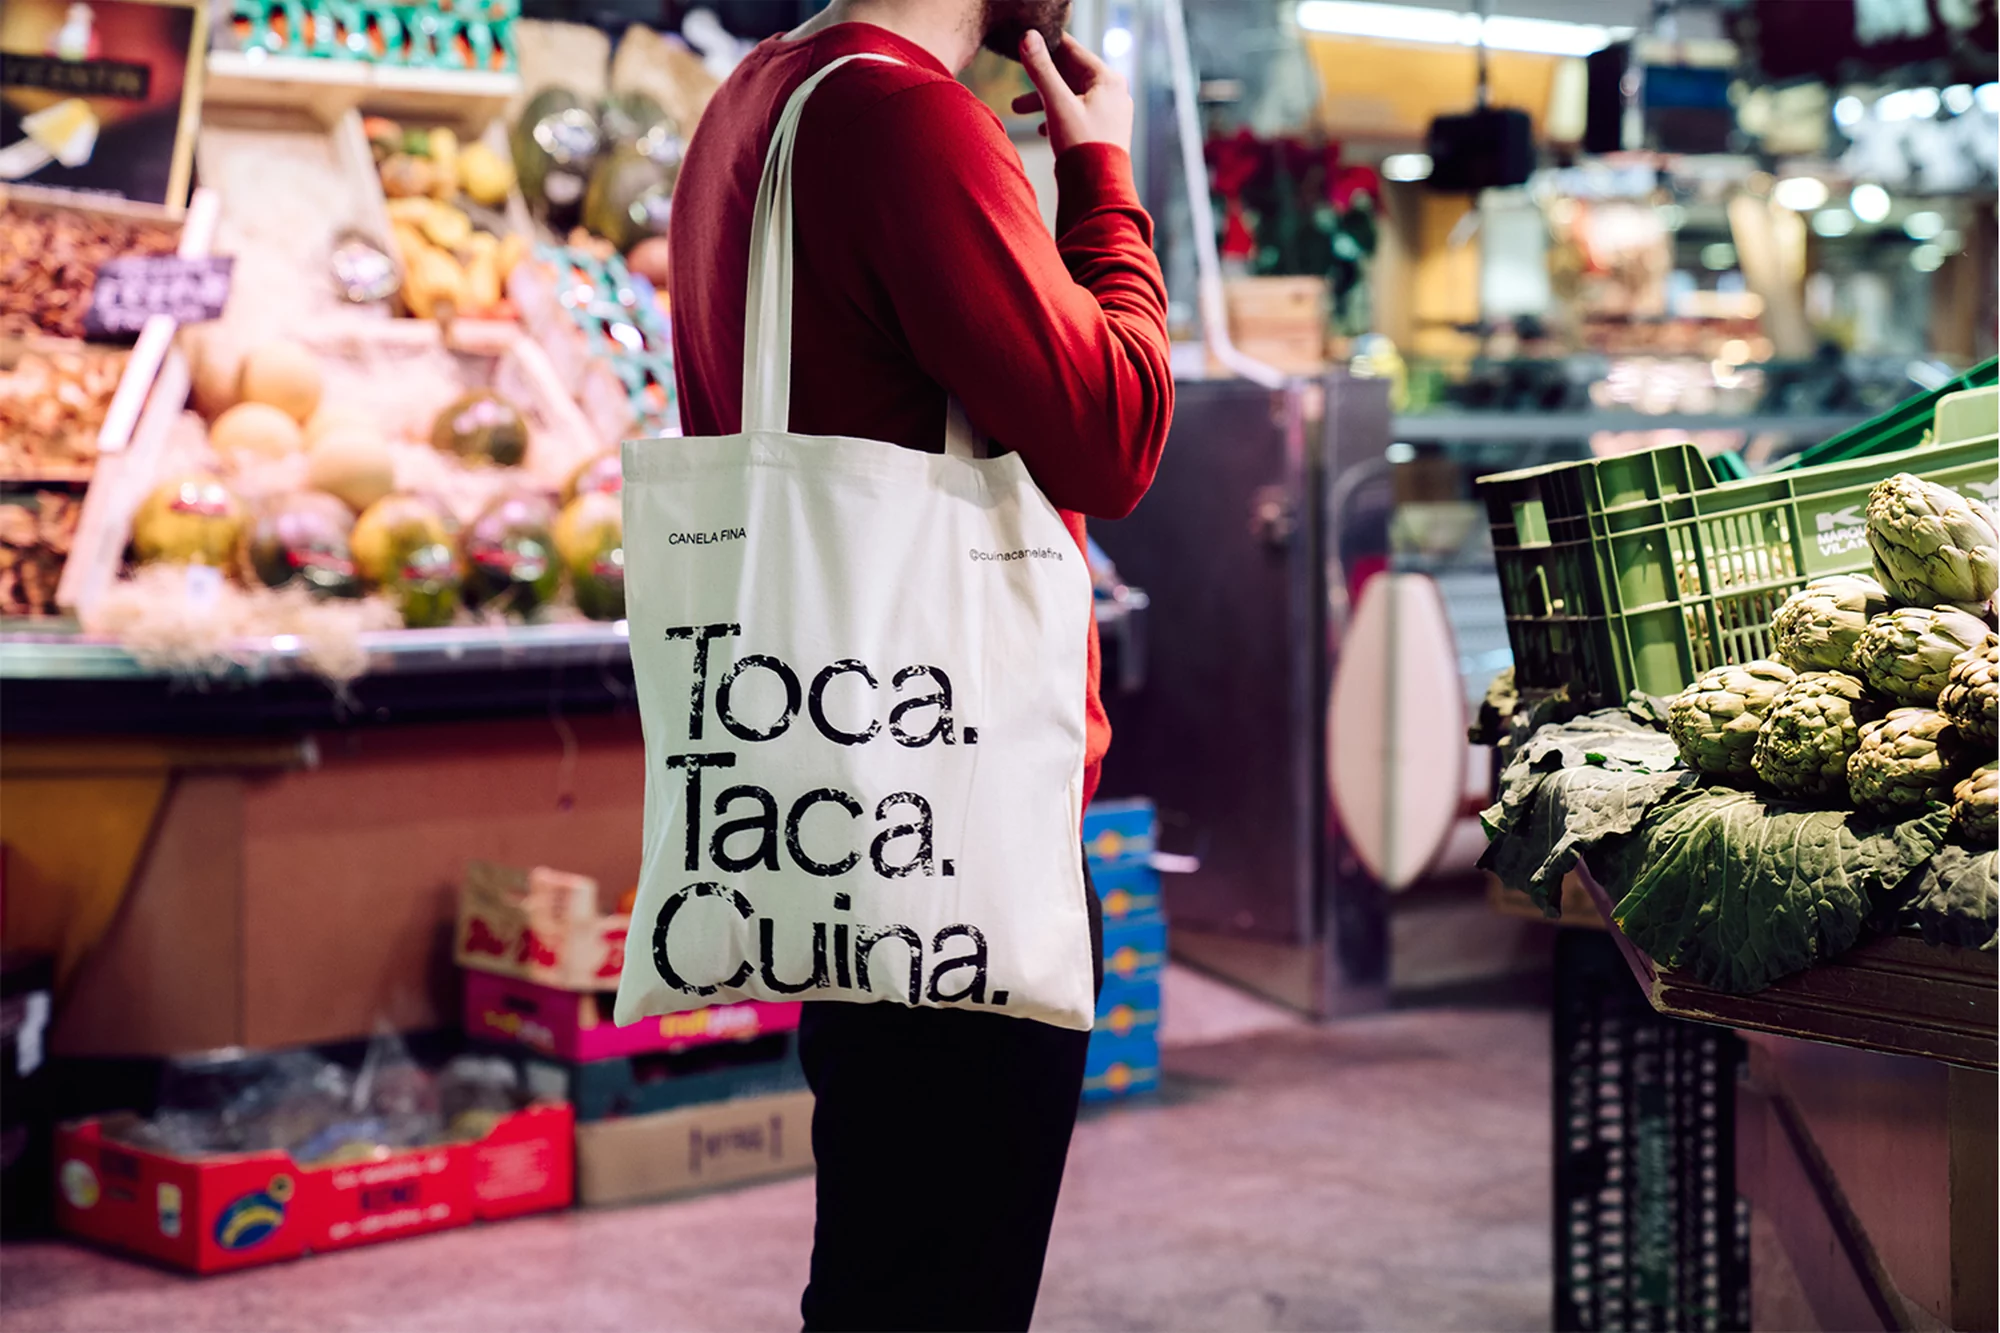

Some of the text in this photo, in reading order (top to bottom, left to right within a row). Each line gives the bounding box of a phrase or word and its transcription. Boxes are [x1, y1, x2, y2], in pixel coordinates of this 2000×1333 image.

[668, 527, 747, 545] CANELA FINA
[1818, 526, 1866, 545] MARQU
[665, 623, 978, 747] Toca.
[666, 752, 955, 878] Taca.
[652, 881, 1009, 1005] Cuina.
